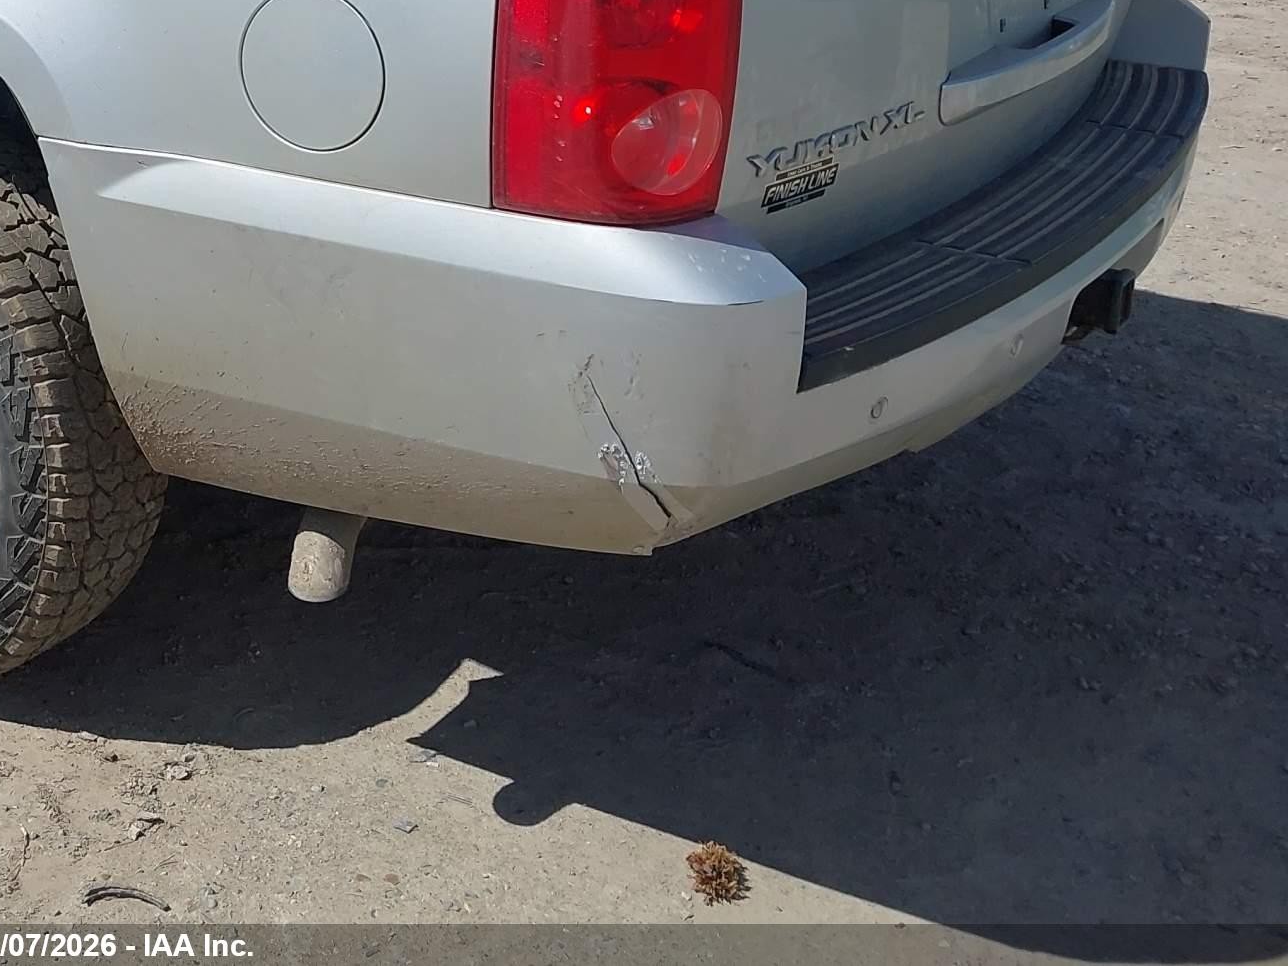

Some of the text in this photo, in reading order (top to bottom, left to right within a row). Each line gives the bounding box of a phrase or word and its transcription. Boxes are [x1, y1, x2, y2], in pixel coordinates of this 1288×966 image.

[879, 100, 925, 136] XL
[764, 177, 809, 205] FINISH
[807, 167, 837, 190] LINE
